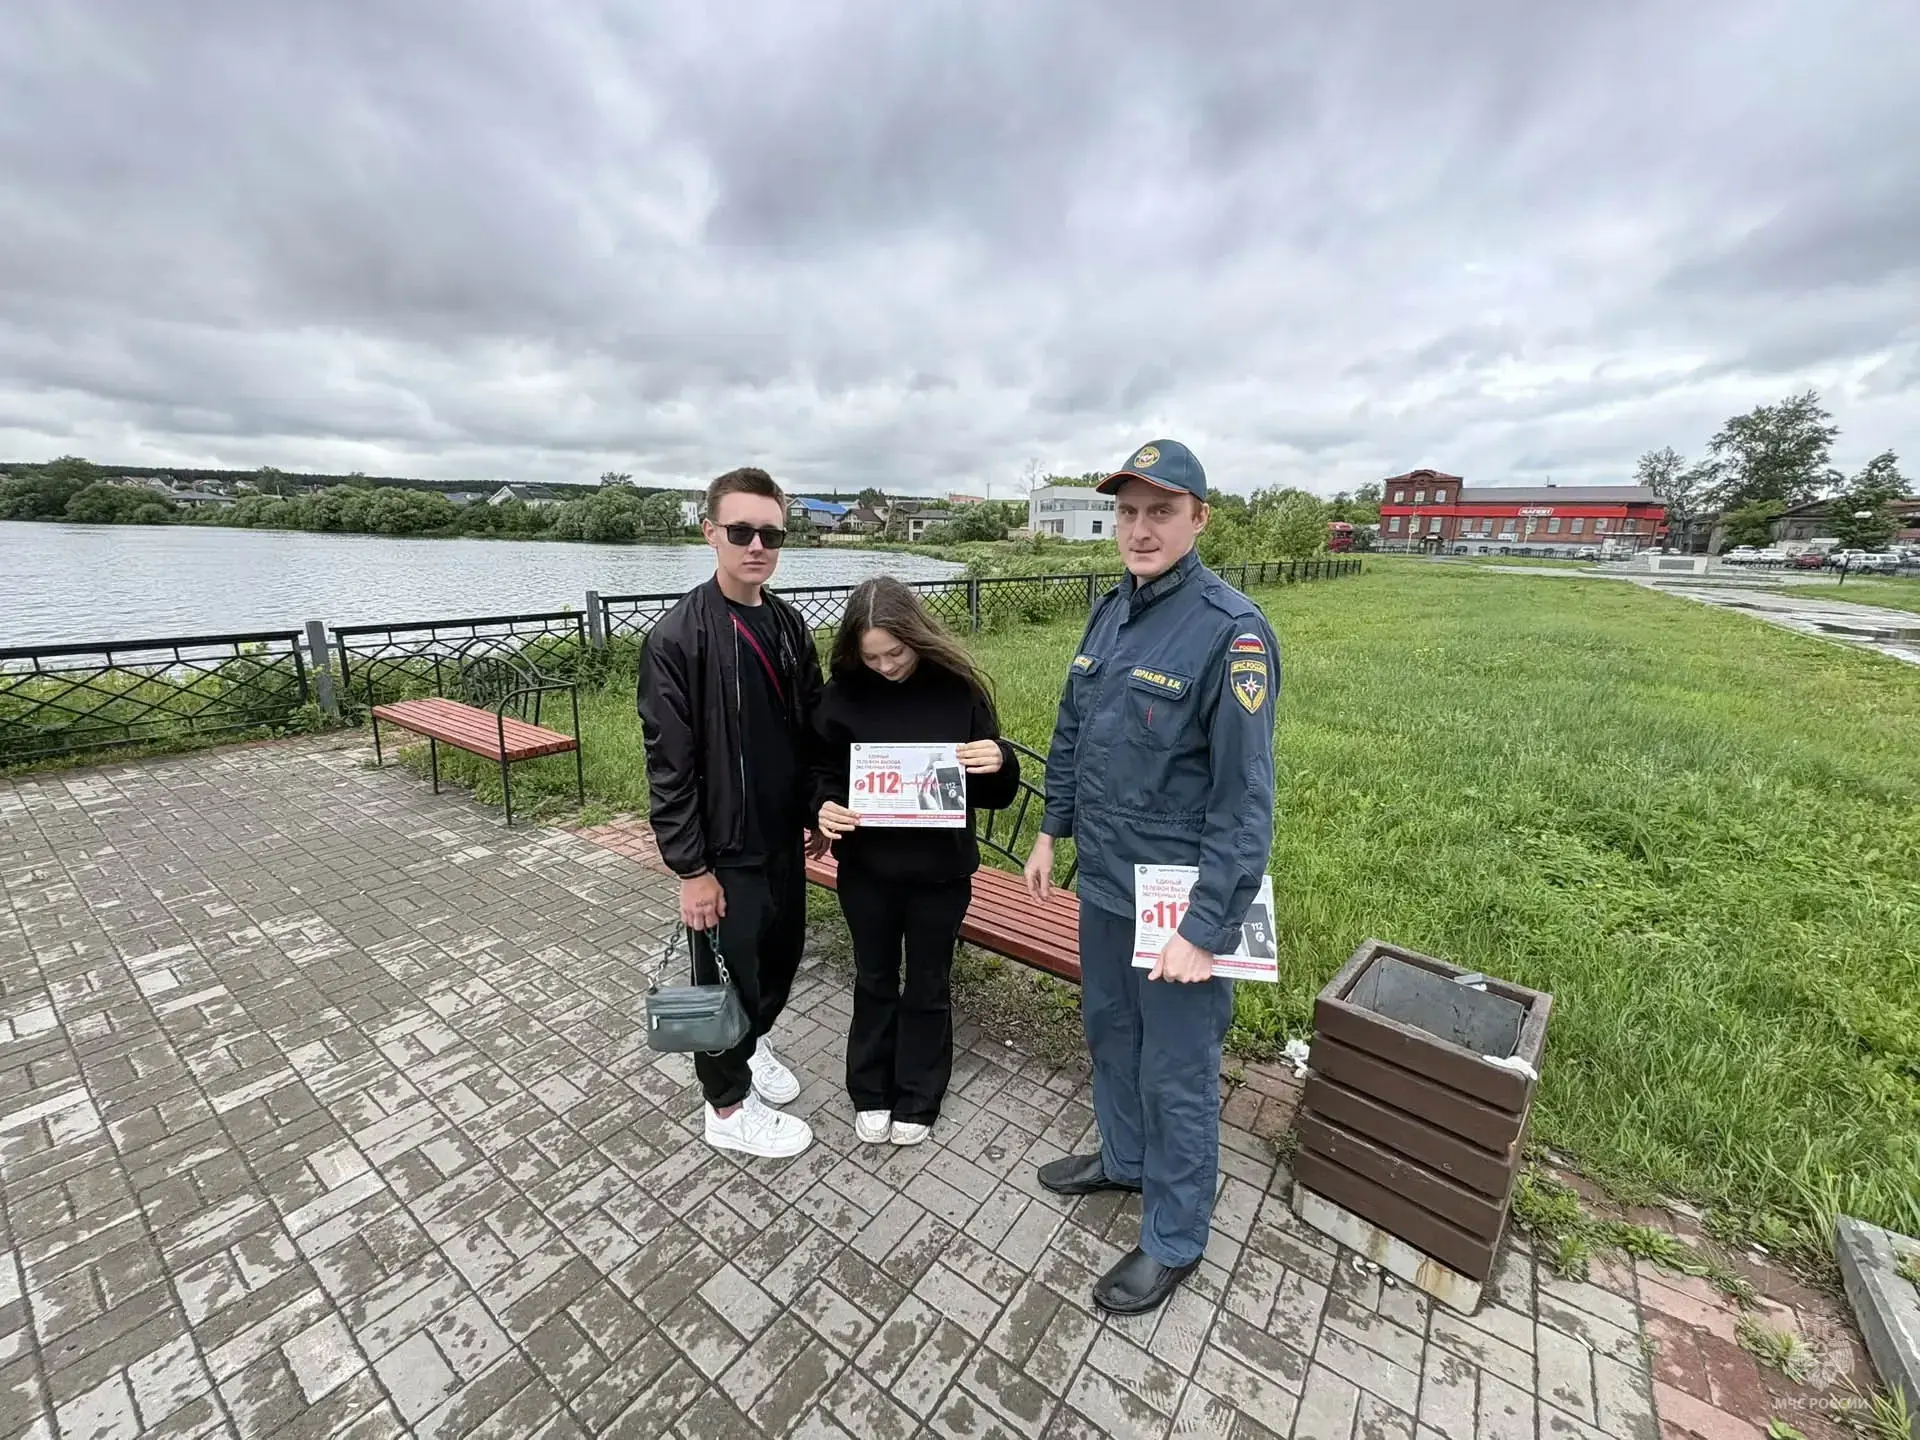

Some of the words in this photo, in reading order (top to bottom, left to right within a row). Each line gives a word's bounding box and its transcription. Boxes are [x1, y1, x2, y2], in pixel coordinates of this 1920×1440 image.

[865, 771, 899, 793] 112
[946, 782, 957, 790] 112
[1251, 922, 1264, 931] 112
